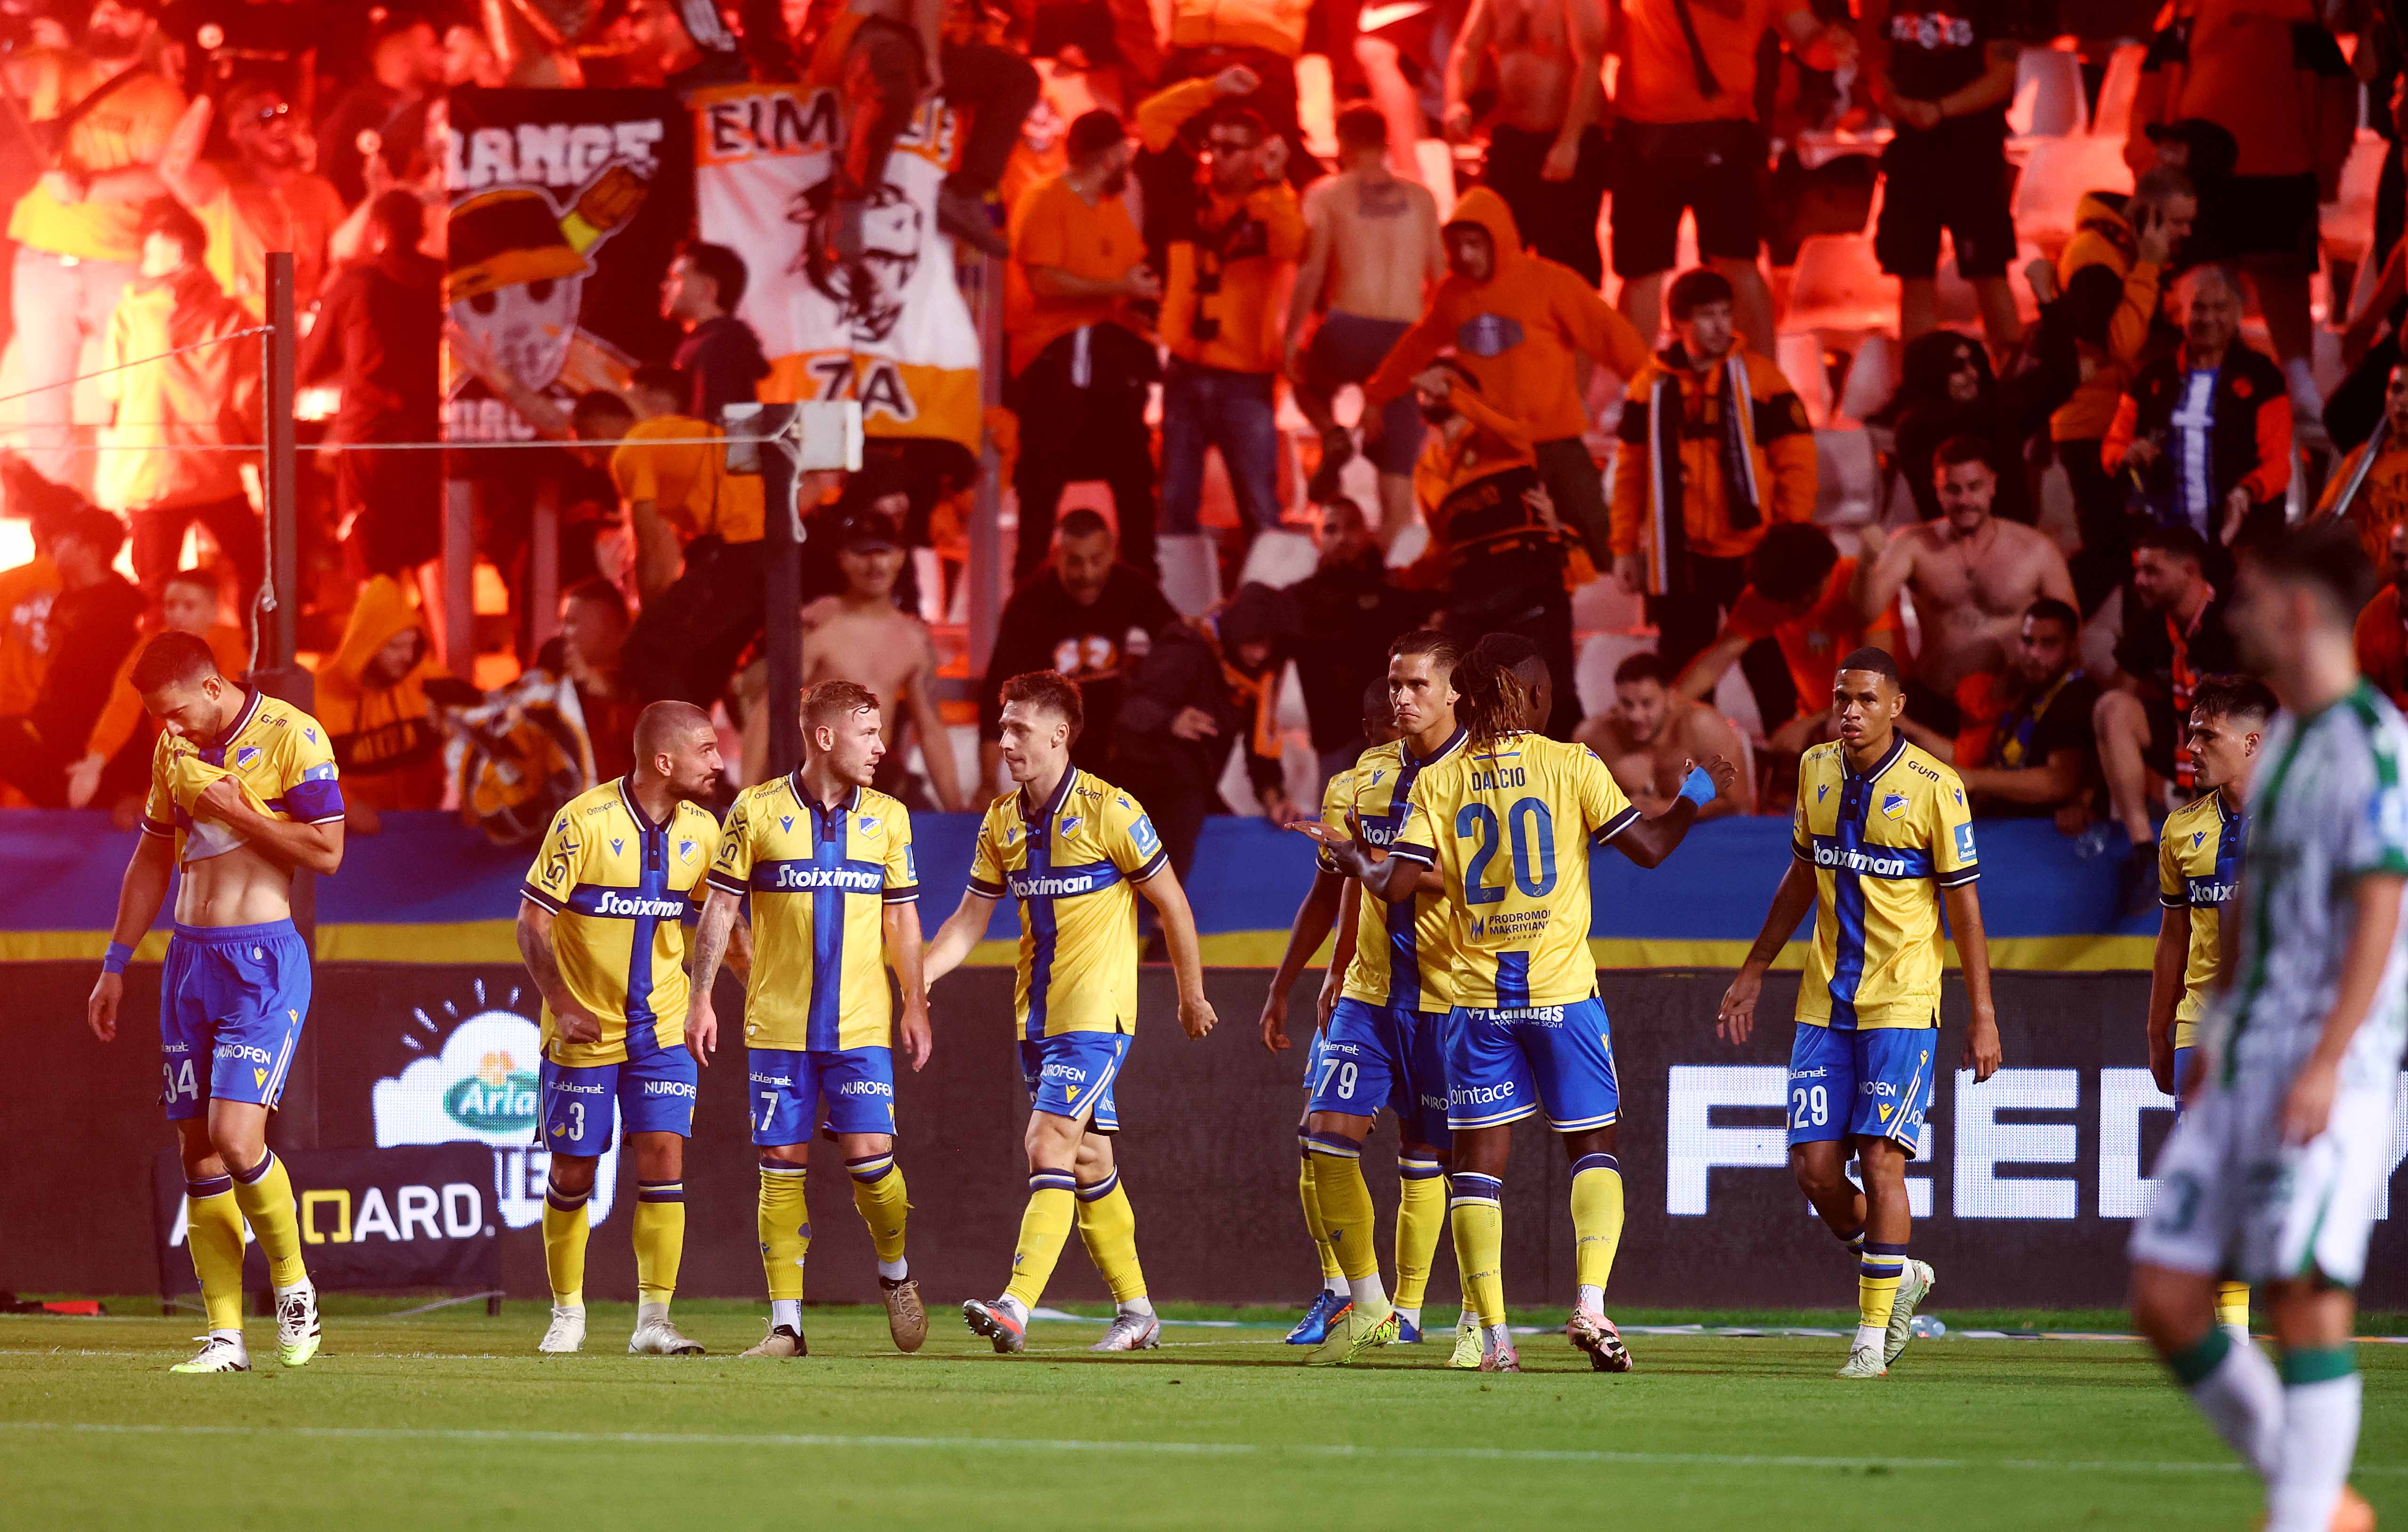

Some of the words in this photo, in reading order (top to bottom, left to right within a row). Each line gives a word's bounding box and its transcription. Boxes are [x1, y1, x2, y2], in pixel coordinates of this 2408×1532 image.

[1472, 767, 1526, 791] DALCIO
[587, 799, 619, 815] Osteocare
[1361, 820, 1398, 846] Stoix
[1456, 797, 1557, 905] 20
[776, 864, 882, 889] Stoiximan
[1007, 875, 1093, 898] toximan
[2190, 879, 2239, 903] Stoixi
[216, 1044, 272, 1065] NUROFEN
[163, 1058, 199, 1104] 34
[644, 1080, 697, 1099] NUROFE
[840, 1080, 893, 1097] NUROFEN
[1317, 1058, 1358, 1099] 79
[459, 1082, 539, 1115] Arla
[1450, 1081, 1514, 1106] ointace
[760, 1091, 779, 1131] 7
[1792, 1085, 1828, 1129] 29
[568, 1102, 585, 1142] 3
